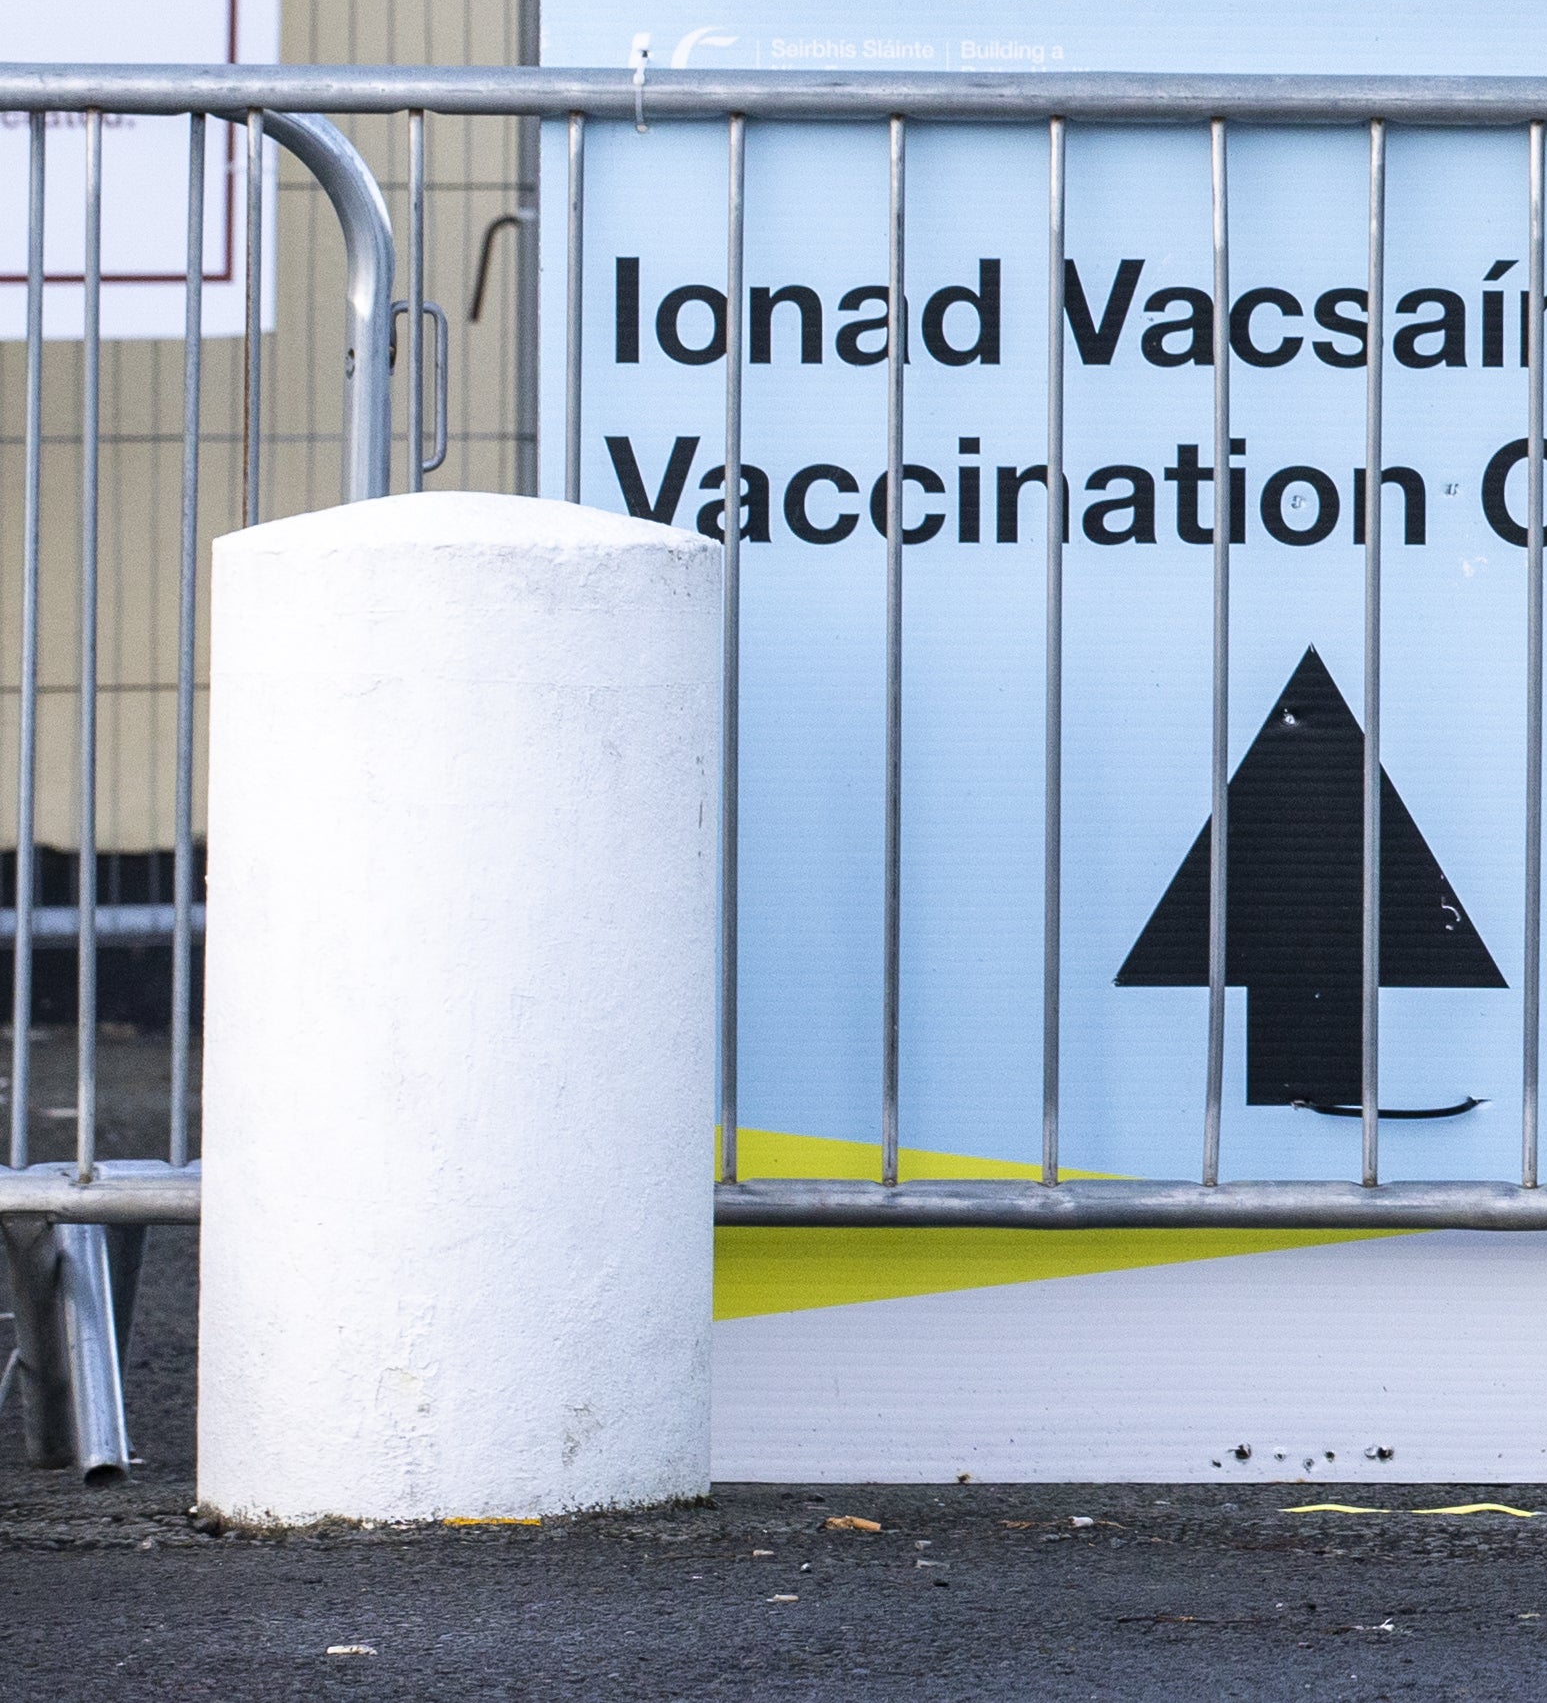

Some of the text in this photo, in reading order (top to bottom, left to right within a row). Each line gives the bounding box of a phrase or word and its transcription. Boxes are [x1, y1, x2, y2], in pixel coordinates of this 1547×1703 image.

[862, 37, 936, 61] Sláinte
[960, 40, 1065, 64] Building a
[614, 255, 1002, 368] Ionad
[603, 435, 1428, 546] Vaccination
